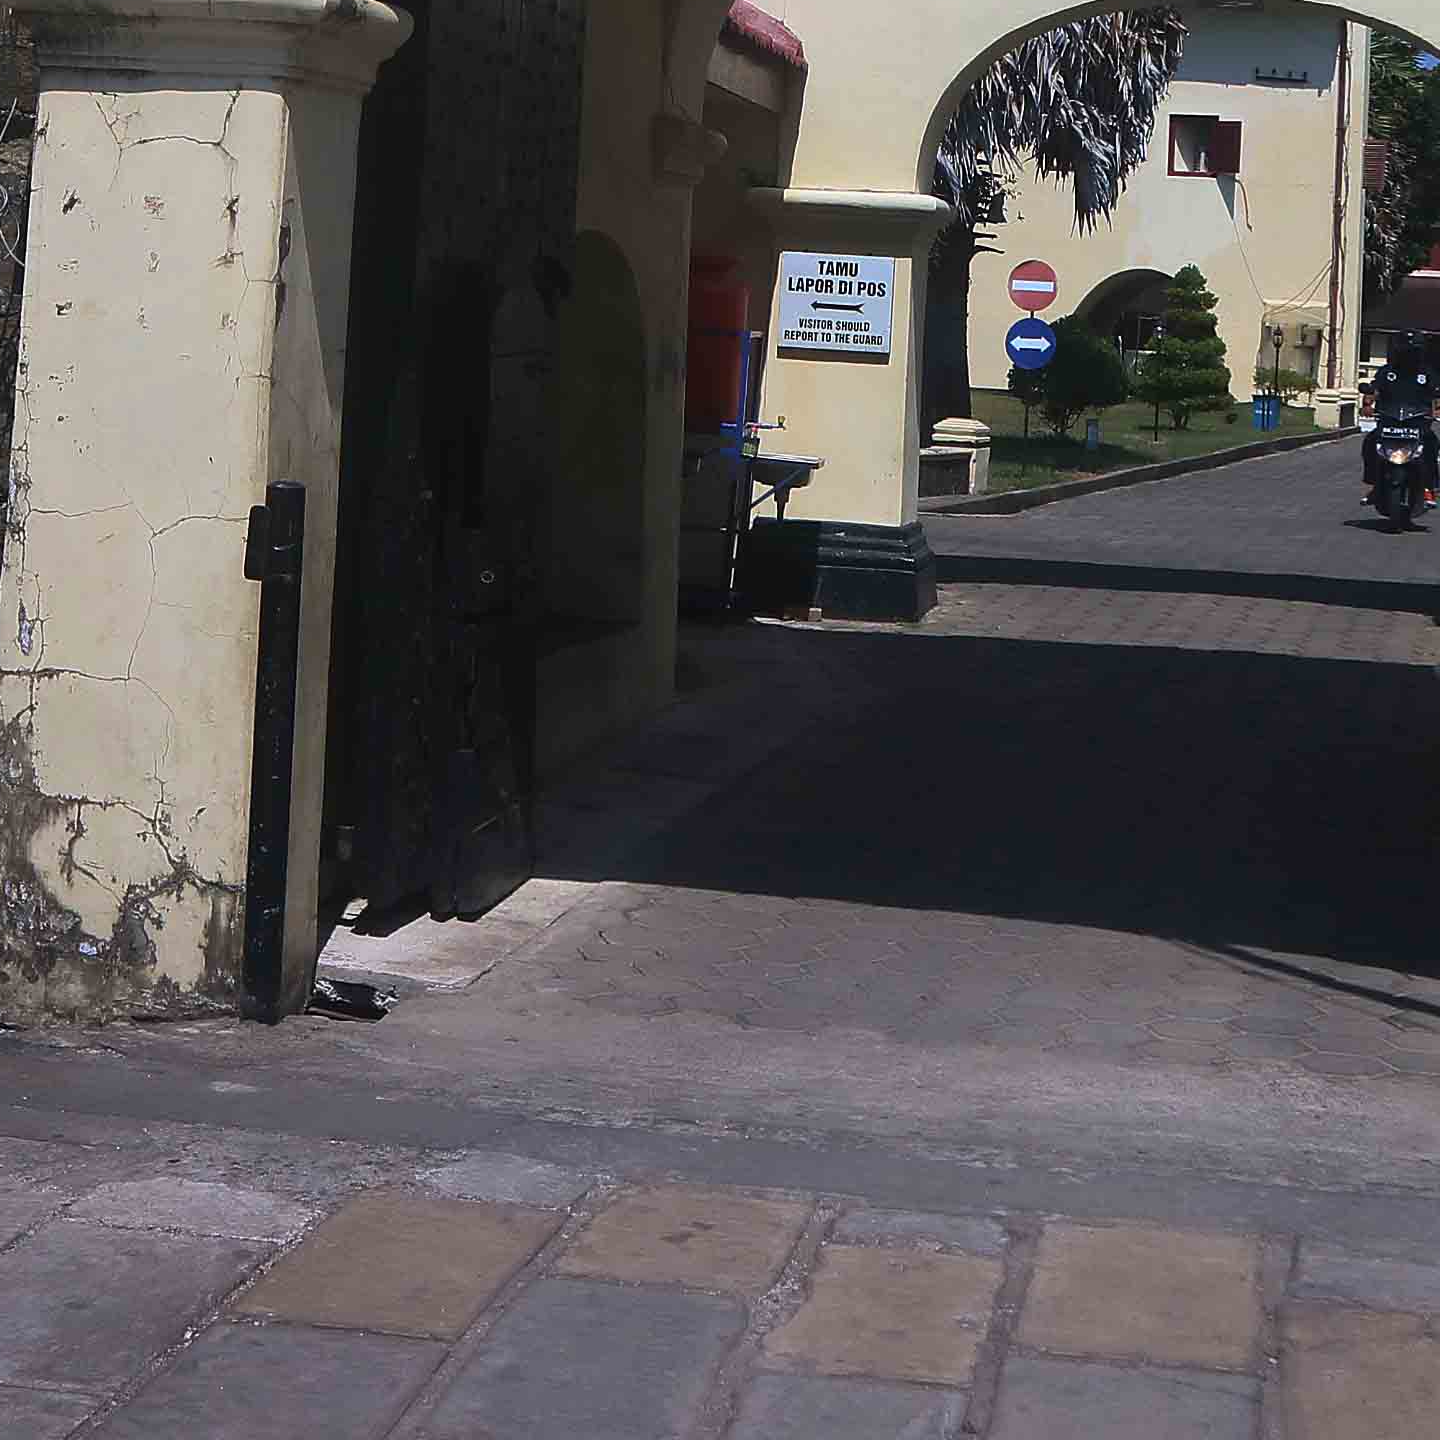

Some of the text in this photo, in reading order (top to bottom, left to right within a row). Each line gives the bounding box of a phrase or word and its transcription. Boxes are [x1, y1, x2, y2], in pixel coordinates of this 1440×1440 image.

[818, 260, 859, 277] TAMU
[788, 276, 887, 298] LAPOR DI POS
[798, 318, 870, 332] VISITOR SHOULD
[783, 329, 883, 346] REPORT TO THE GUARD
